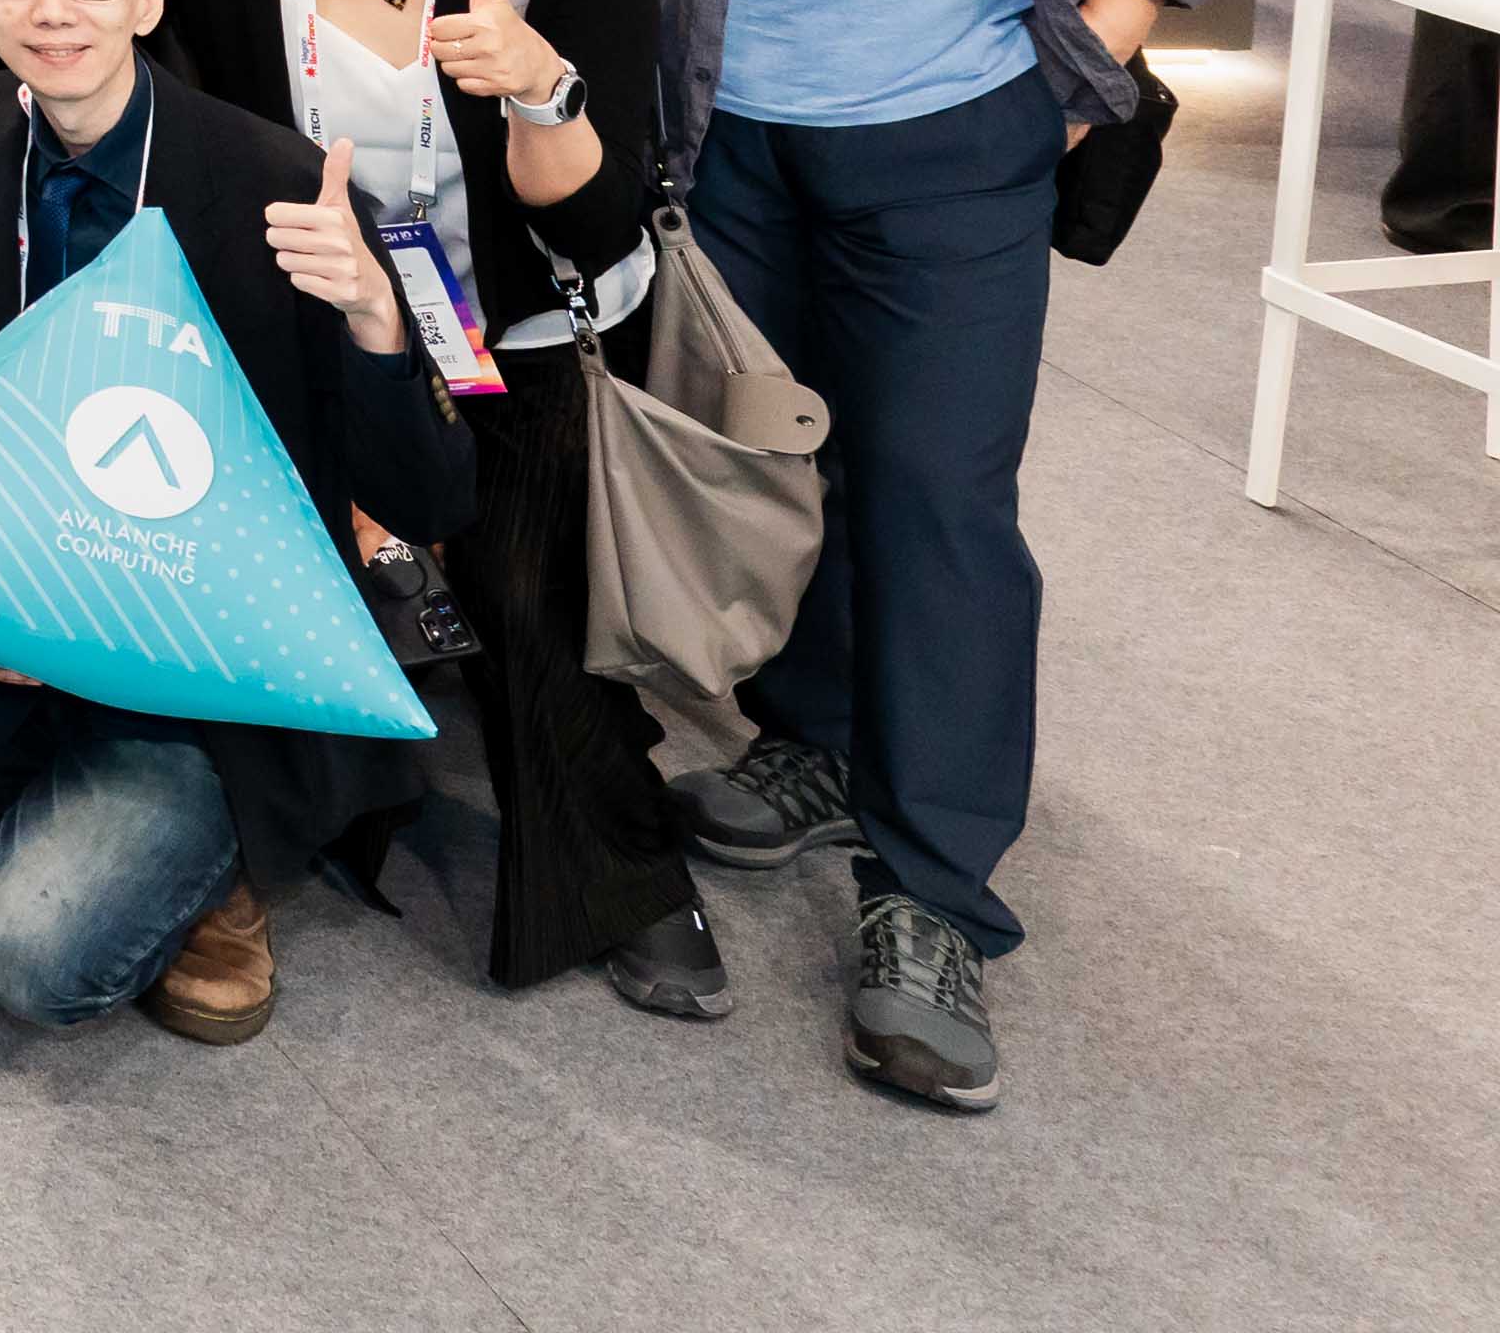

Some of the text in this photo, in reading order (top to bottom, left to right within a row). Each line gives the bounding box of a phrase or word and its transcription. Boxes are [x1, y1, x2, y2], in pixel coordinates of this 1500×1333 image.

[419, 97, 433, 149] VIVATECH
[92, 299, 213, 368] TTA
[55, 532, 197, 586] COMPUTING
[58, 507, 200, 562] AVALANCHE
